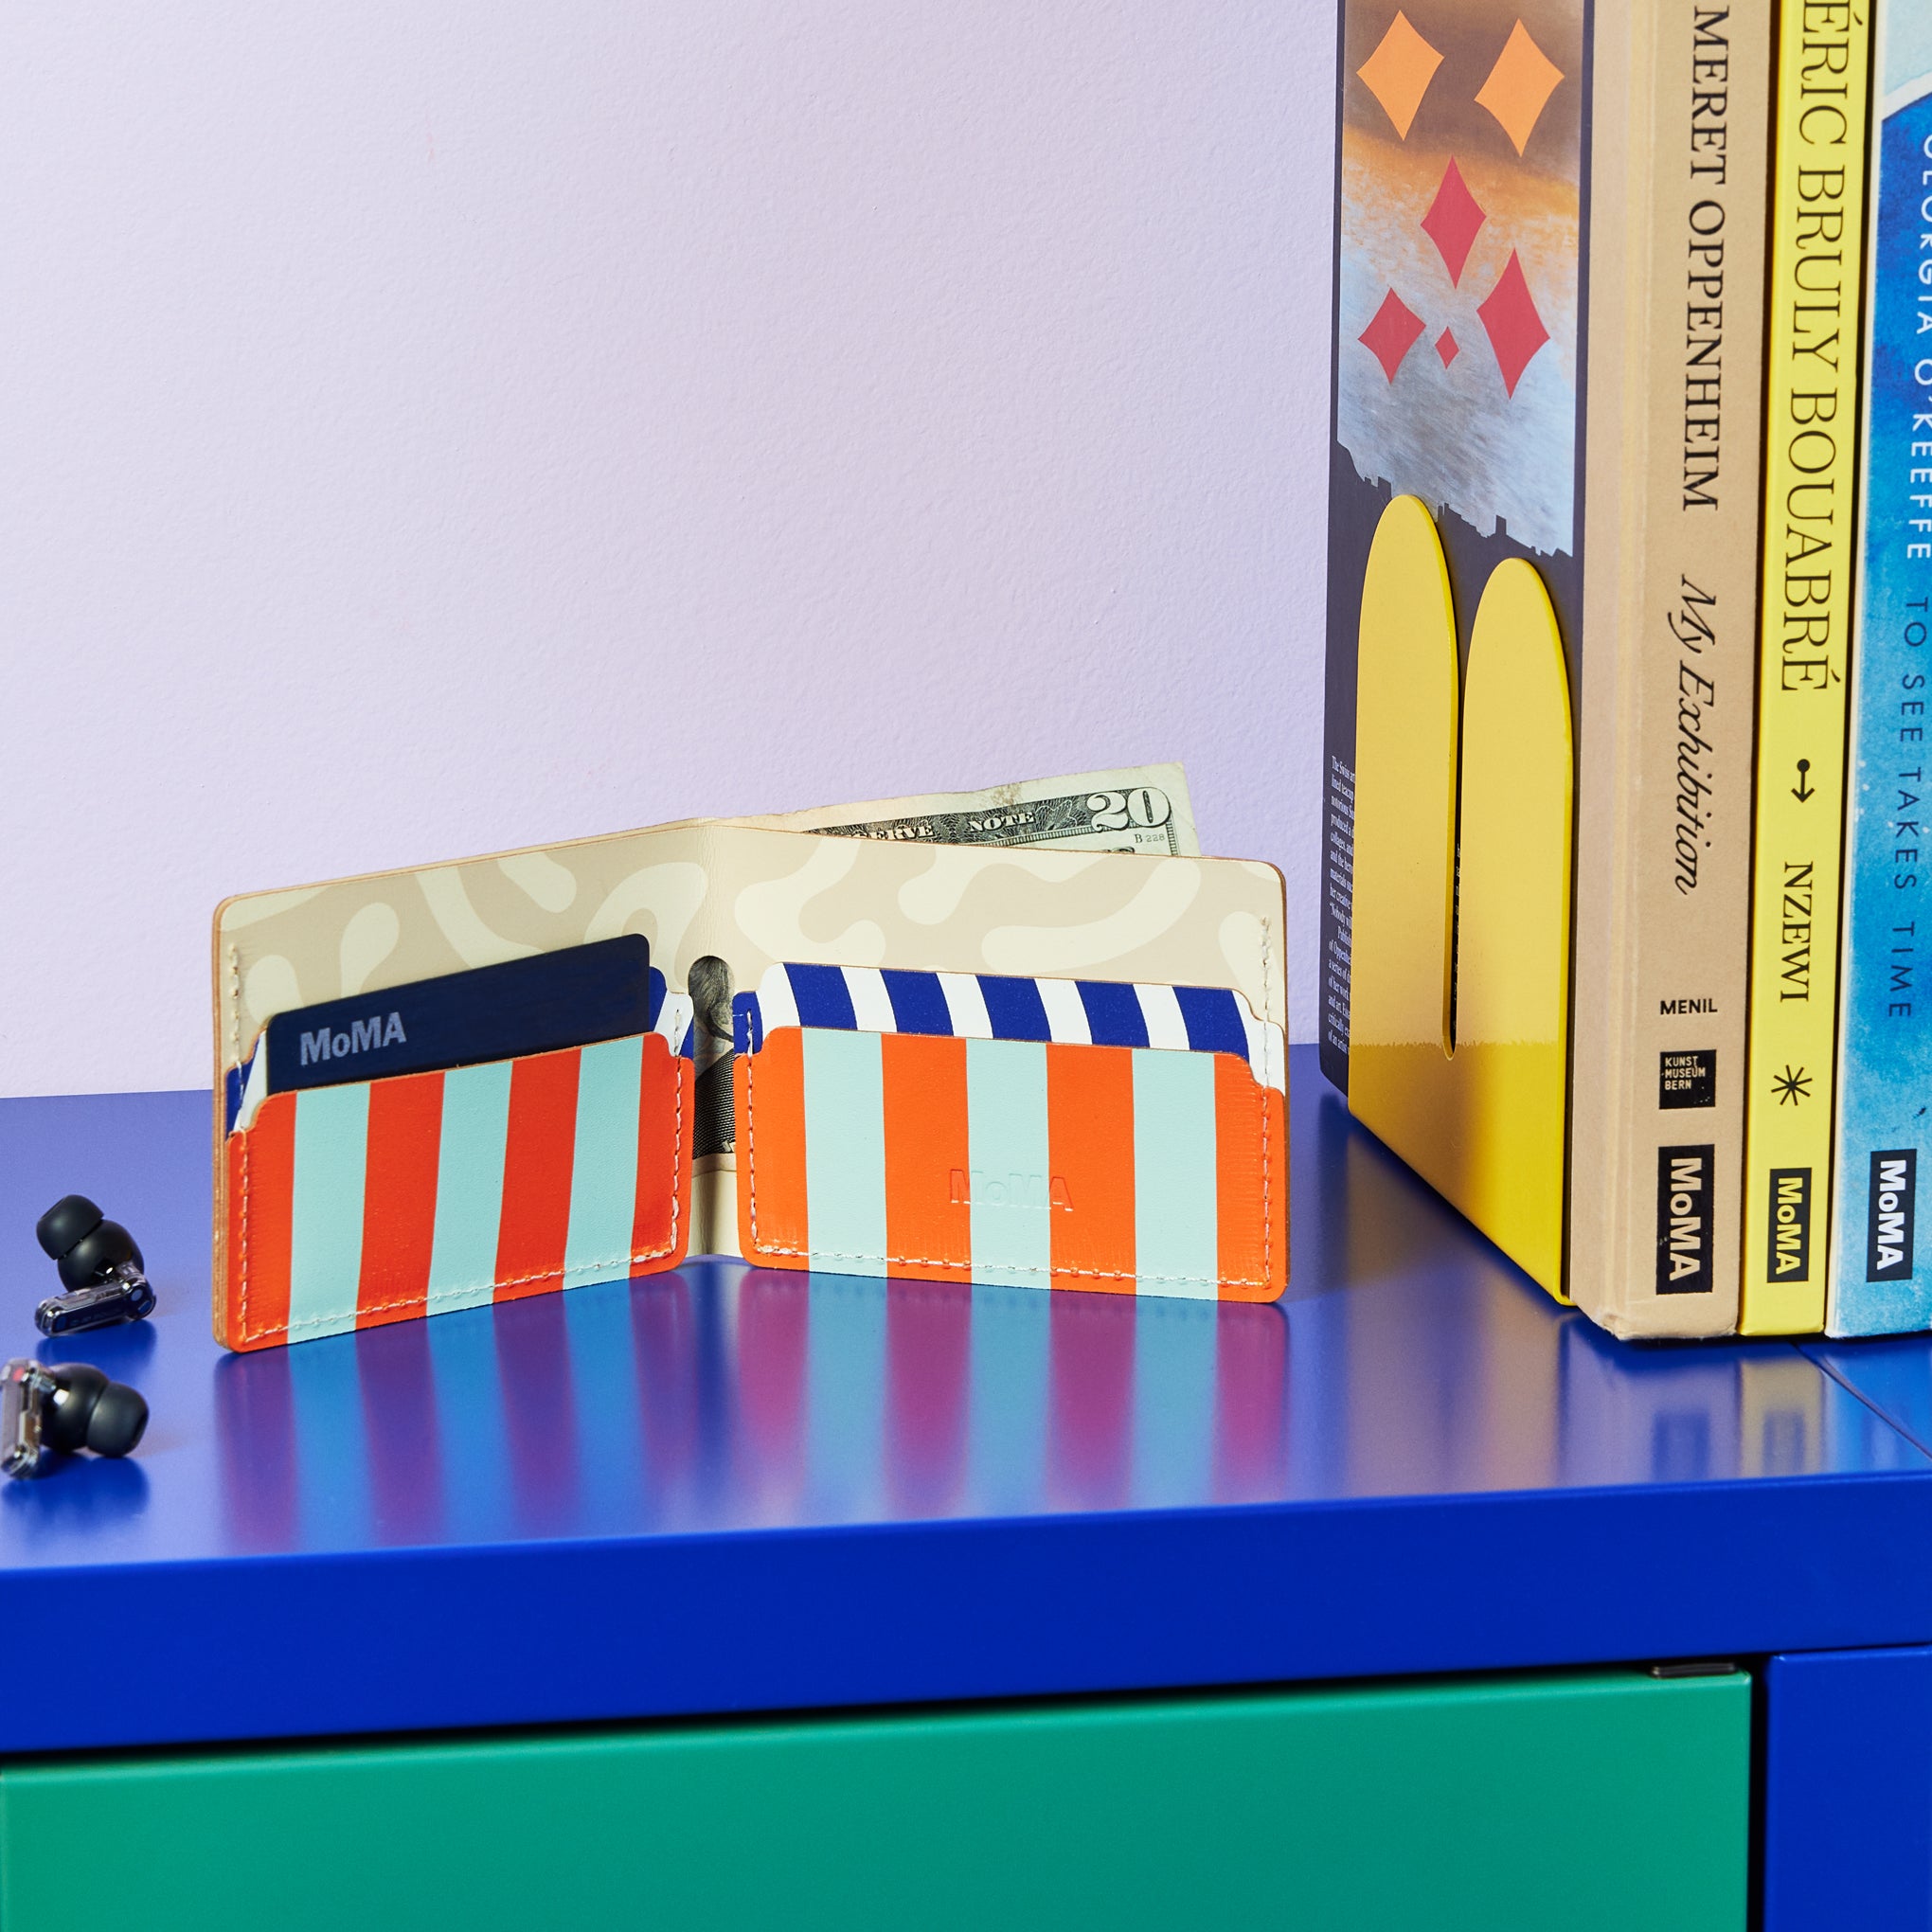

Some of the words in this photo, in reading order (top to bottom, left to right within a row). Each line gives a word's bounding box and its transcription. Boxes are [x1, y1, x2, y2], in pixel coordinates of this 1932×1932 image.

[1690, 6, 1729, 185] MERET
[1799, 0, 1863, 144] ÉRIC
[1793, 165, 1845, 372] BRULY
[1683, 200, 1726, 511] OPPENHEIM
[1782, 388, 1841, 691] BOUABRÉ
[1667, 574, 1716, 654] My
[1904, 597, 1928, 646] TO
[1900, 674, 1925, 742] SEE
[1086, 786, 1172, 832] 20
[1674, 659, 1715, 895] Exhibition
[968, 812, 1036, 834] NOTE
[1134, 833, 1143, 843] B
[1145, 833, 1166, 843] 228
[1894, 766, 1922, 888] TAKES
[1780, 861, 1813, 1002] NZEWI
[1888, 921, 1915, 1017] TIME
[299, 1012, 406, 1065] MoMA
[1660, 998, 1718, 1015] MENIL
[1665, 1056, 1698, 1067] KUNST
[1665, 1066, 1706, 1079] MUSEUM
[1665, 1080, 1691, 1090] BERN
[950, 1169, 1073, 1211] MoMA
[1665, 1157, 1702, 1281] MoMA
[1775, 1177, 1803, 1275] MoMA
[1877, 1159, 1906, 1271] MoMA
